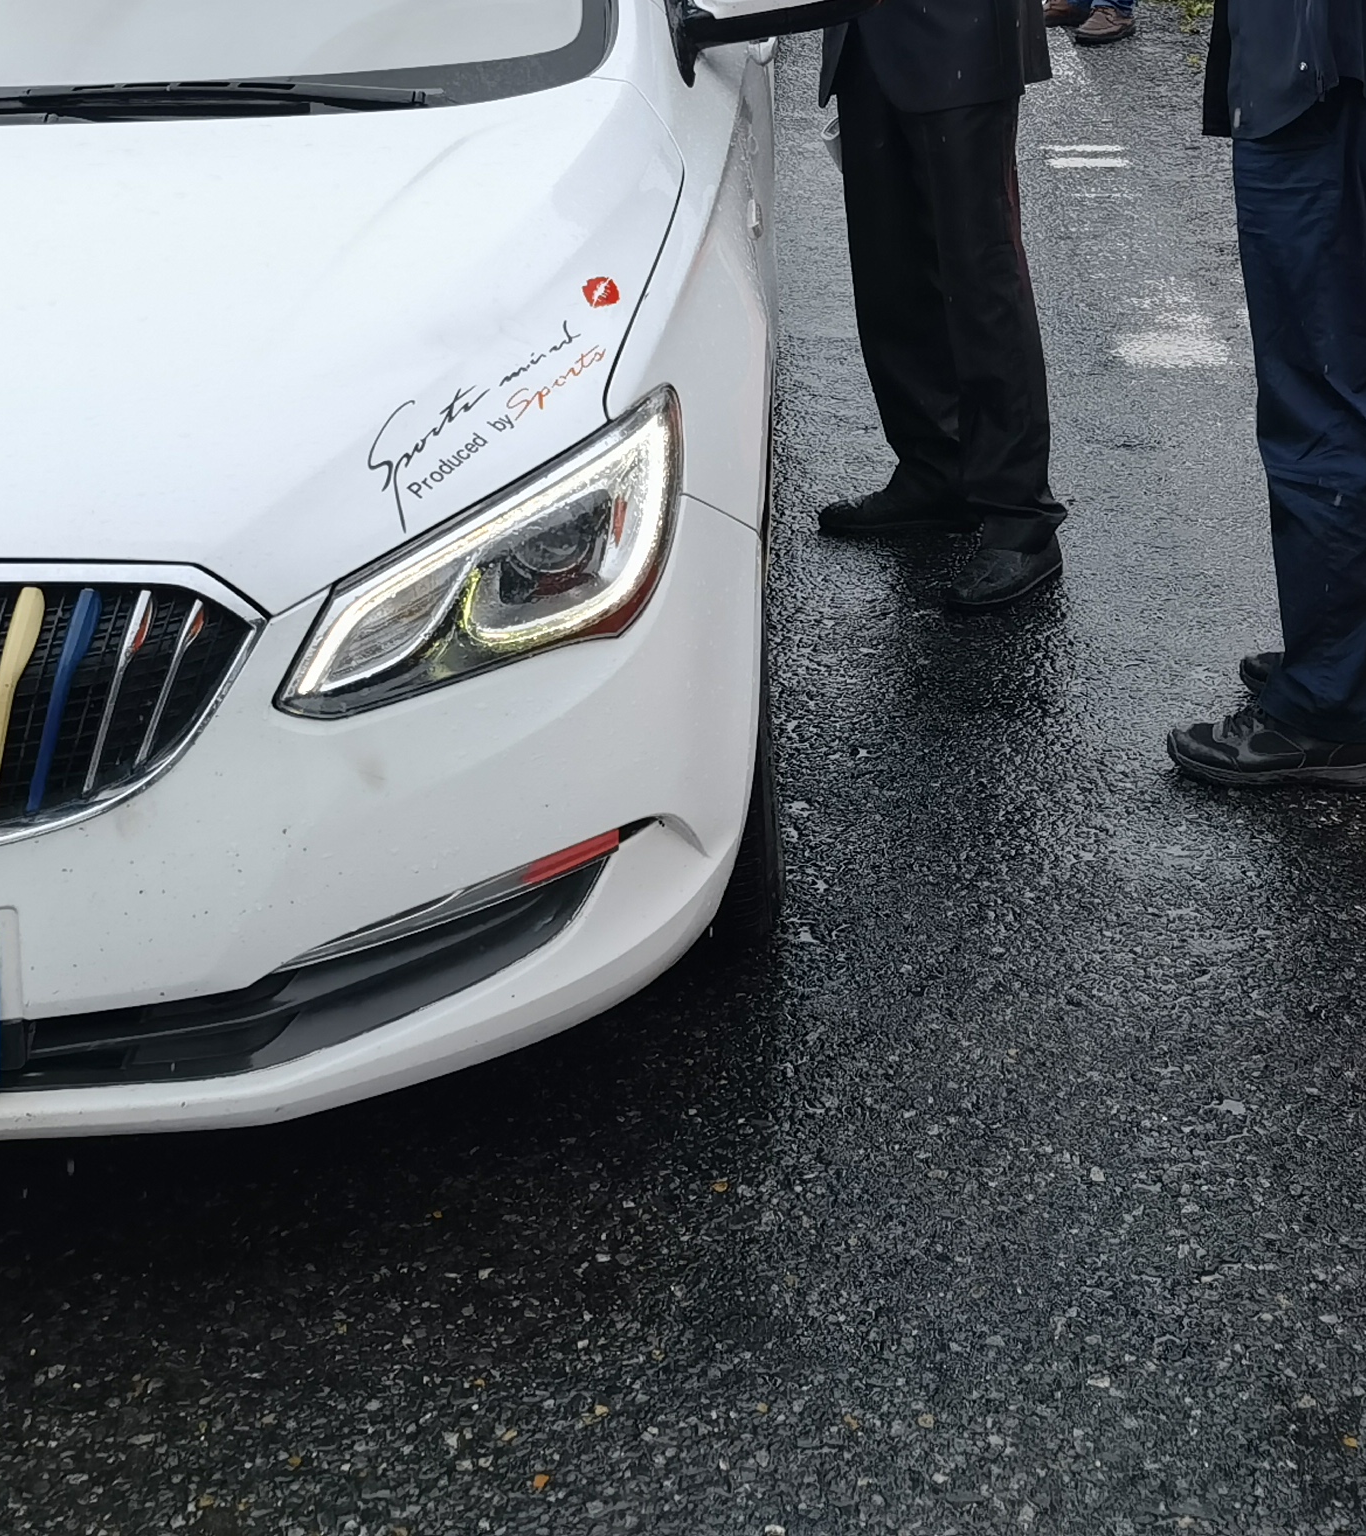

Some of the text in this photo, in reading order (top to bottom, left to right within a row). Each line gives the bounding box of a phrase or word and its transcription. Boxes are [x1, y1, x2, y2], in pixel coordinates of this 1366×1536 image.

[406, 345, 606, 499] Produced by Sports
